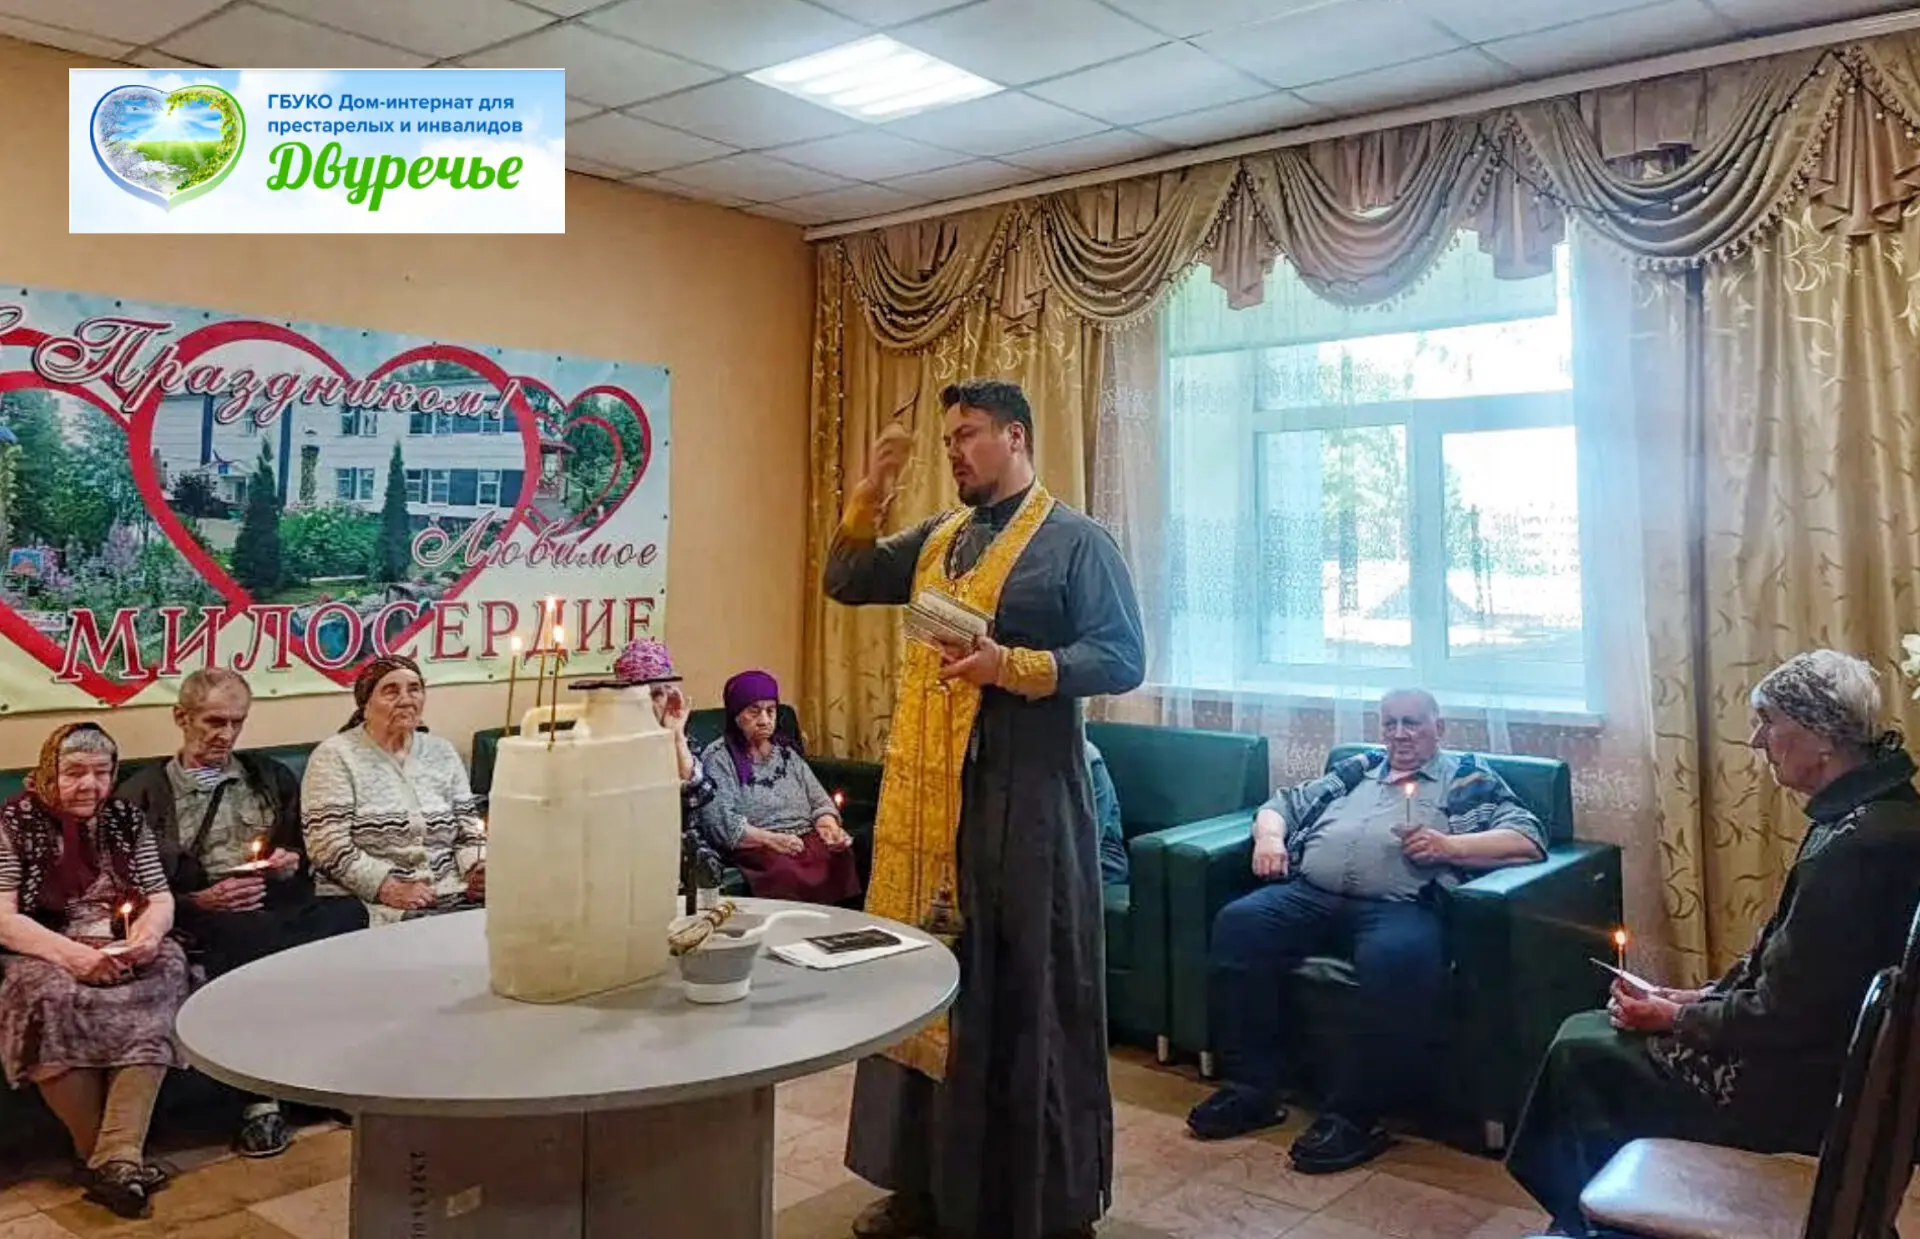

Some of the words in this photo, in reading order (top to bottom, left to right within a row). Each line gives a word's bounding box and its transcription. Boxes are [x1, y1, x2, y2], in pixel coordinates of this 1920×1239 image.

[32, 316, 521, 426] Праздником!
[410, 509, 658, 568] Любимое
[52, 597, 657, 684] МИЛОСЕРДИЕ
